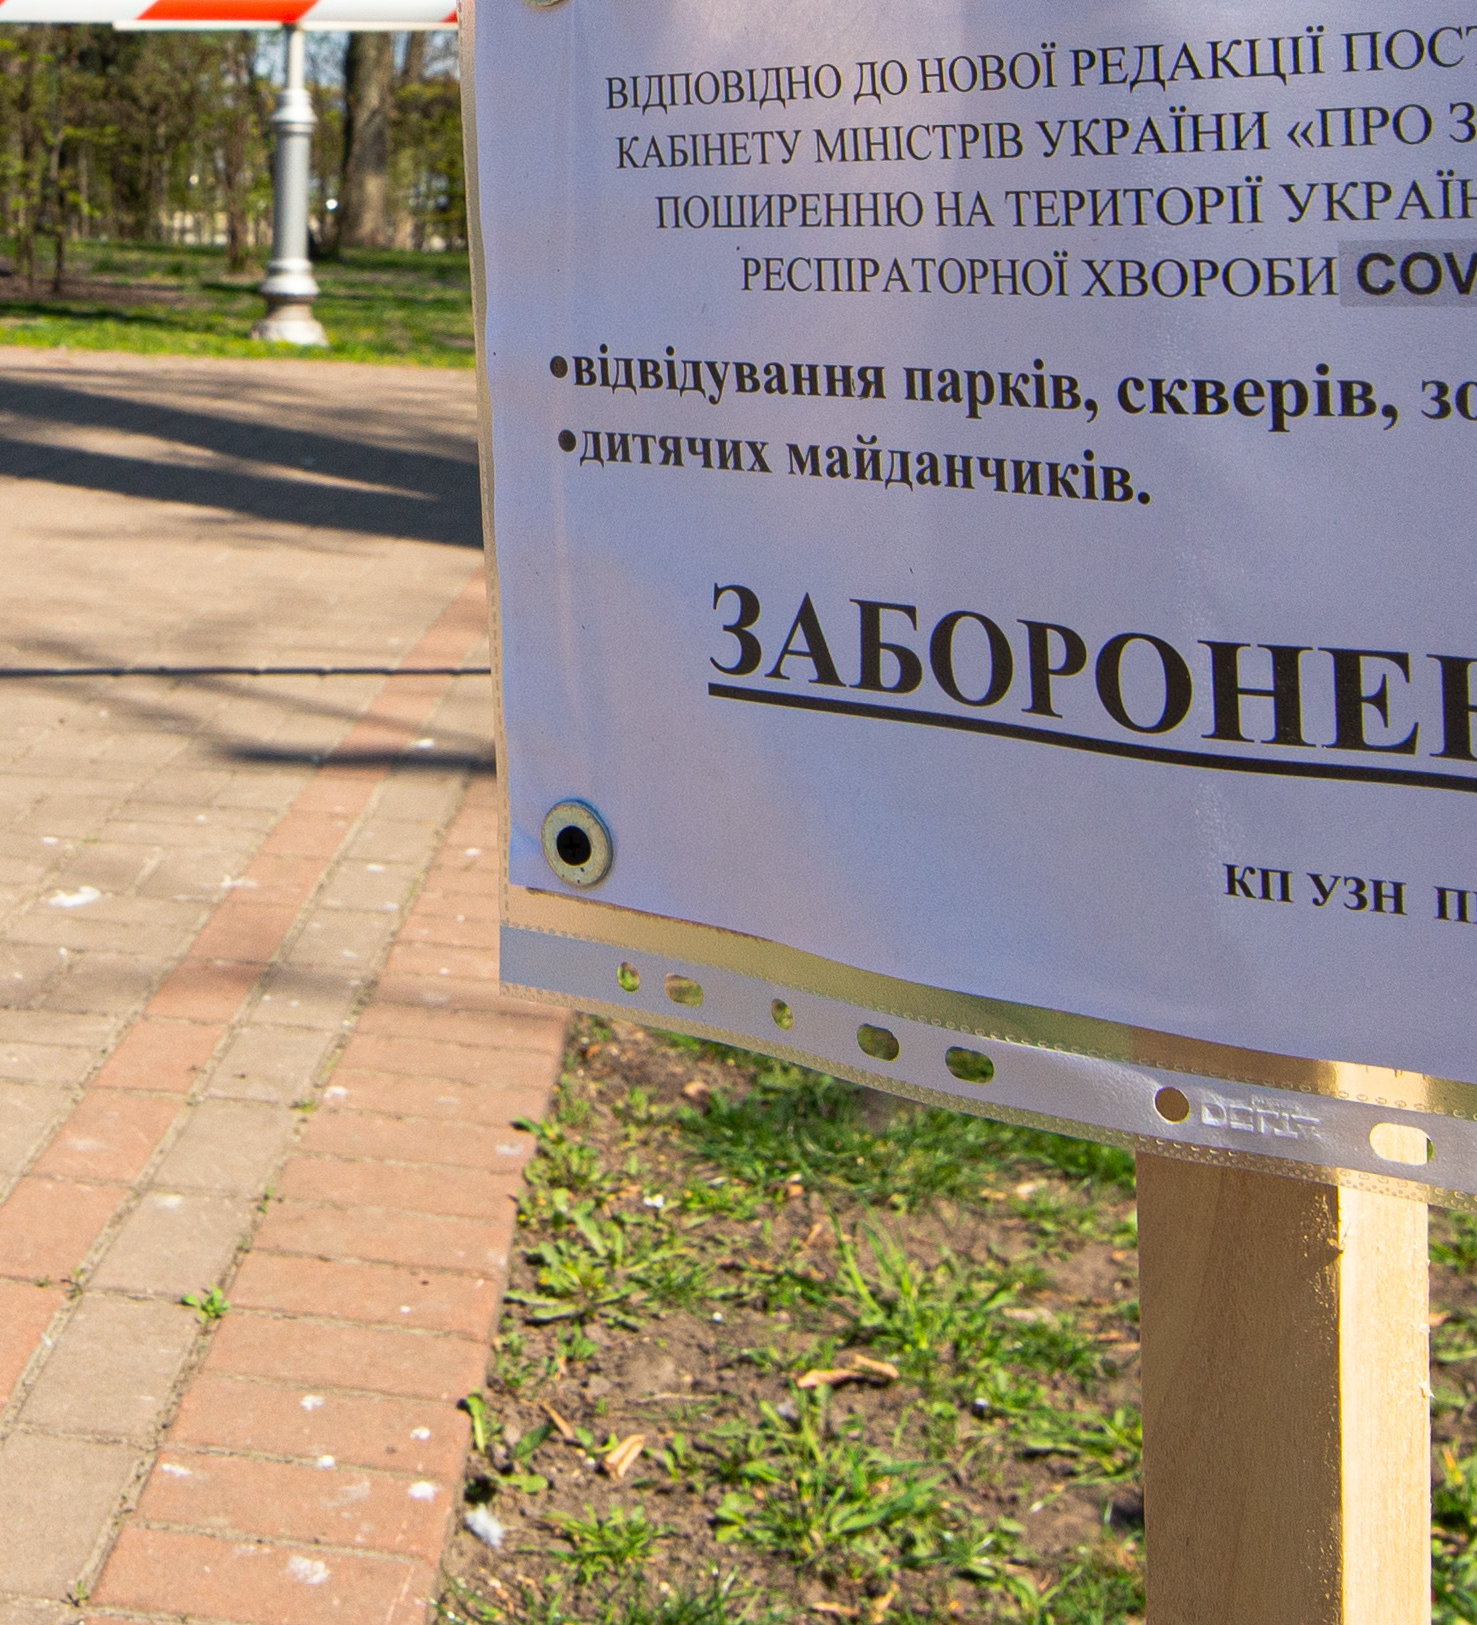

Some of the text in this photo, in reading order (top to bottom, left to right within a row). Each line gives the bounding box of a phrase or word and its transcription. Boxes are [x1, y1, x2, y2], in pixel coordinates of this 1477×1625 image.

[606, 64, 841, 115] ВІДПОВІДНО
[854, 60, 907, 104] ДО
[918, 42, 1056, 93] НОВОЇ
[1069, 25, 1324, 92] РЕДАКЦІЇ
[616, 130, 801, 168] КАБІНЕТУ
[814, 123, 1022, 162] МІНІСТРІВ
[1035, 106, 1269, 157] УКРАЇНИ
[1287, 104, 1432, 147] «ПРО
[656, 192, 923, 228] ПОШИРЕННЮ
[934, 191, 994, 226] НА
[1005, 176, 1262, 226] ТЕРИТОРІЇ
[742, 251, 1068, 296] РЕСПІРАТОРНОЇ
[1082, 257, 1337, 297] ХВОРОБИ
[573, 344, 886, 404] відвідування
[904, 359, 1097, 422] парків,
[1118, 364, 1397, 432] скверів,
[580, 431, 1150, 504] дитячих майданчиків.
[1223, 864, 1292, 902] КП
[1307, 873, 1407, 915] УЗН
